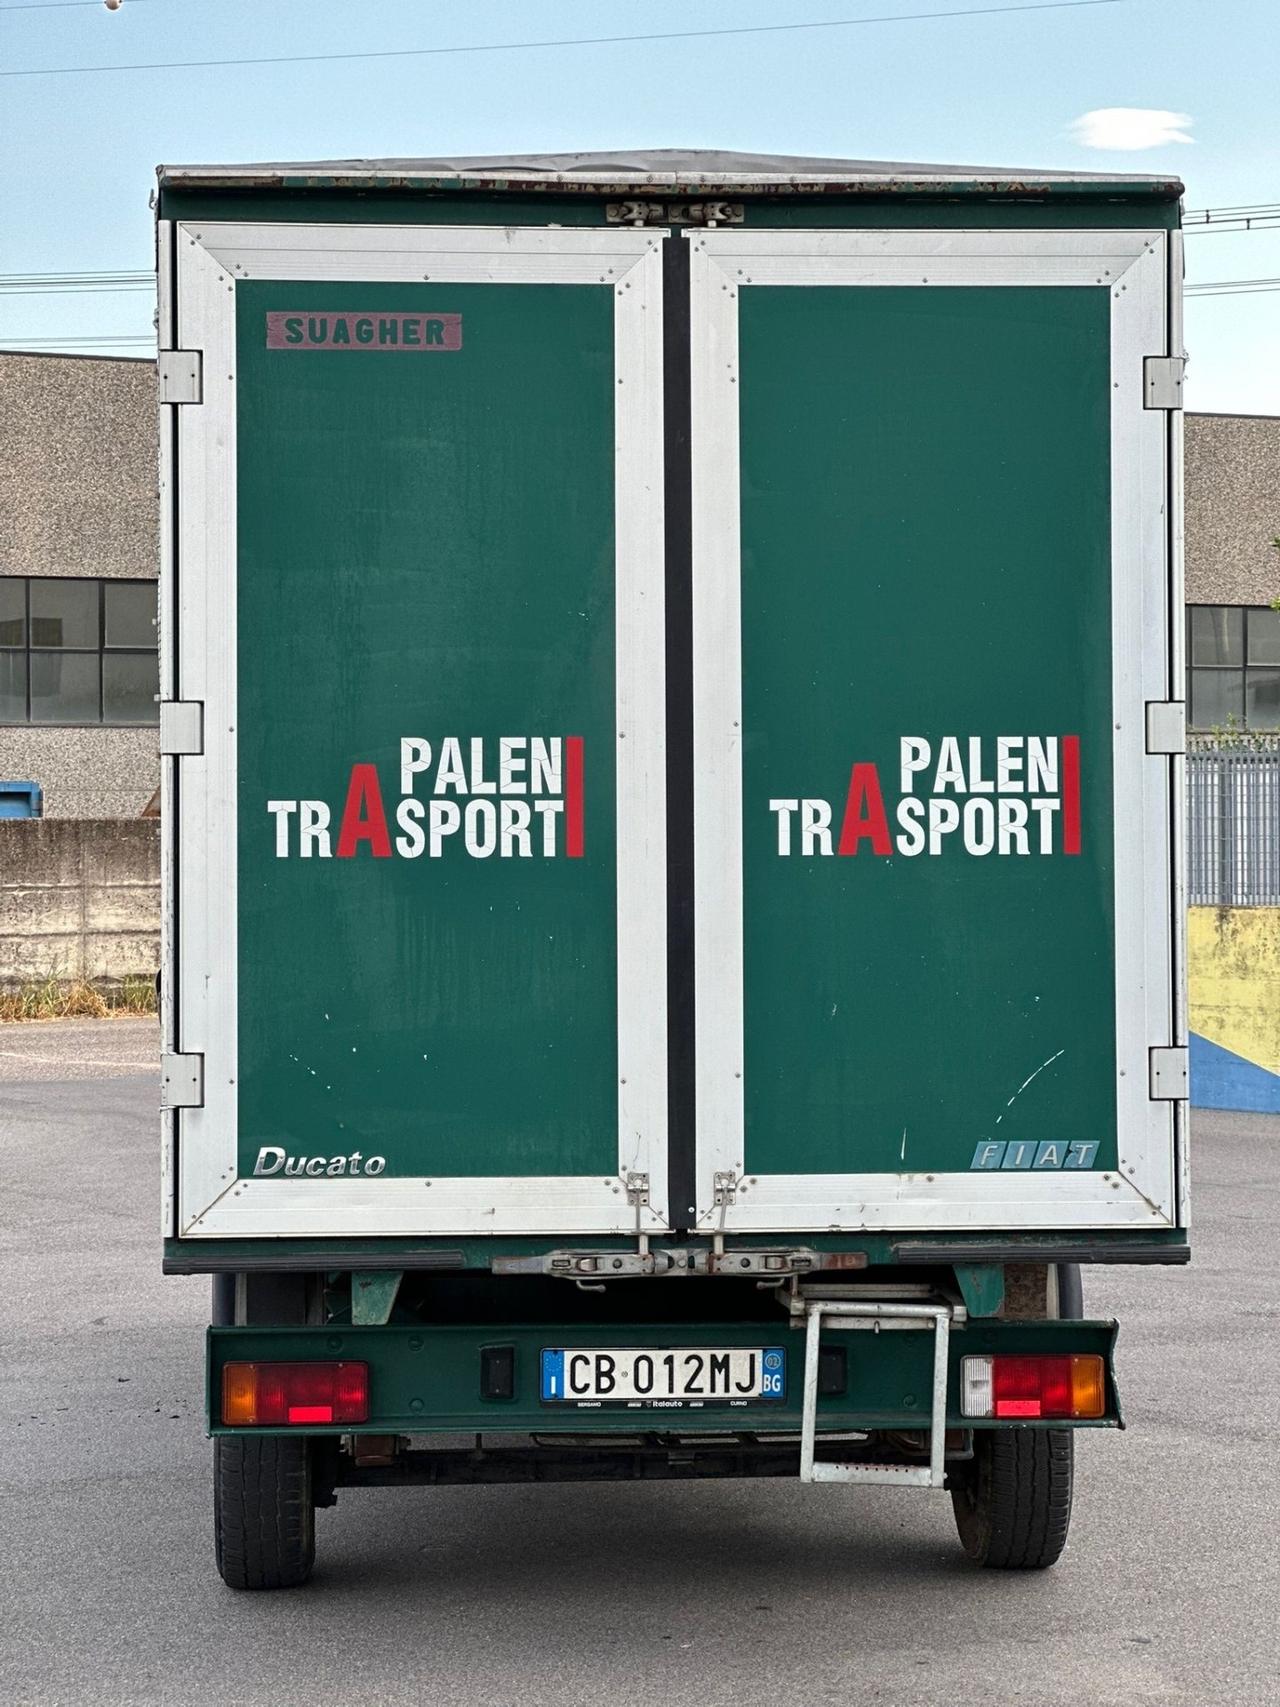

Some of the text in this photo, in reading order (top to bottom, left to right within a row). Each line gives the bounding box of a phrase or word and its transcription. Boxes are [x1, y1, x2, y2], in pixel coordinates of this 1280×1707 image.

[284, 317, 445, 345] SUAGHER
[253, 1146, 386, 1176] Ducato
[979, 1144, 1094, 1166] FIAT
[763, 1374, 781, 1393] BG
